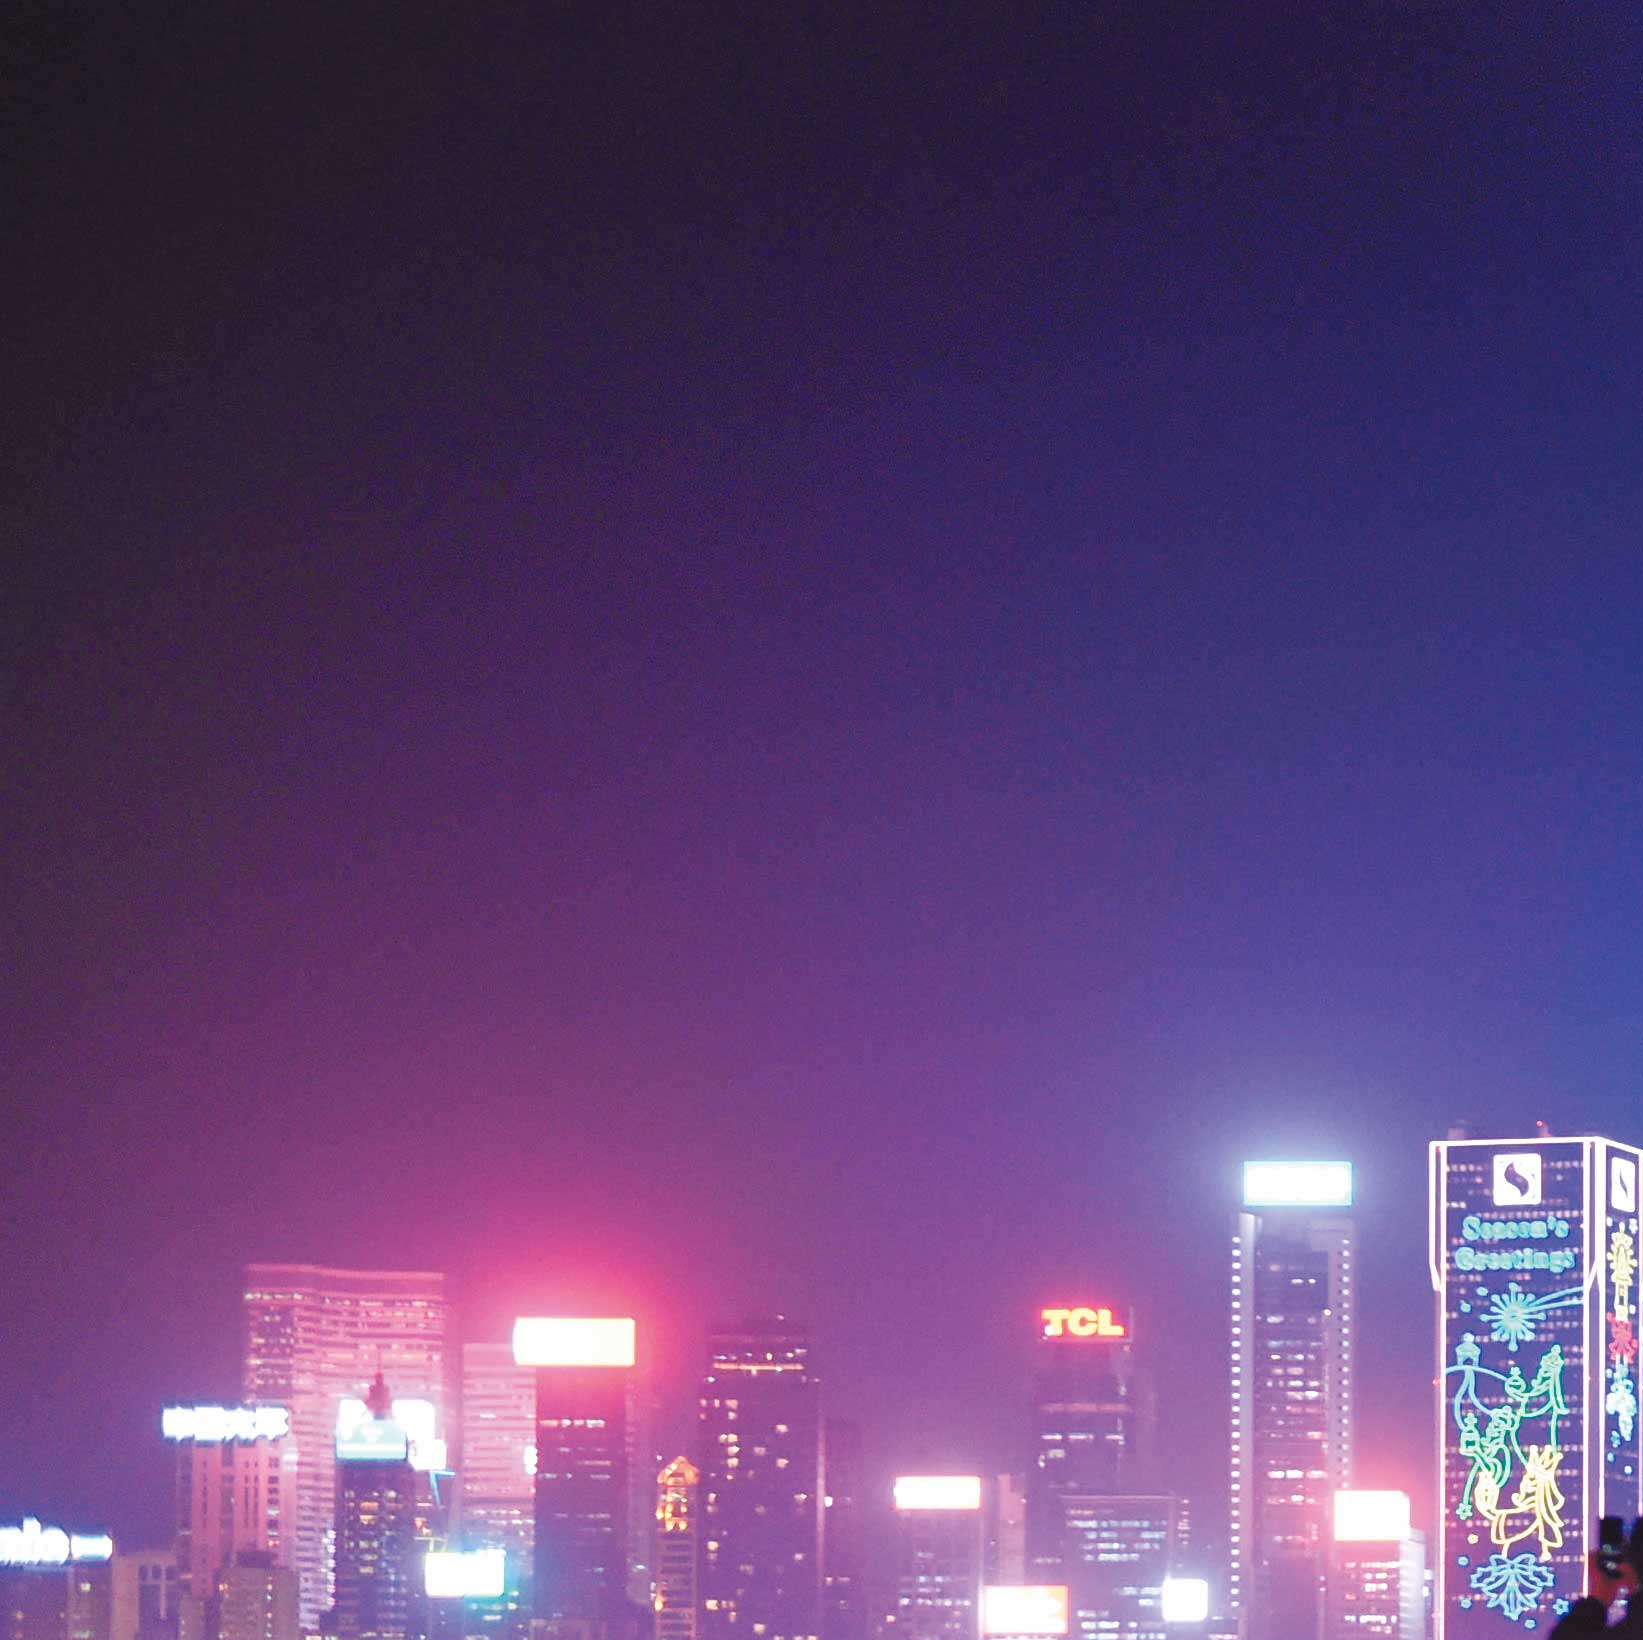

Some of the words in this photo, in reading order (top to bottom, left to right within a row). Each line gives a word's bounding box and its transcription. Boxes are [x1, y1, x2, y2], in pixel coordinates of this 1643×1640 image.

[1462, 1215, 1569, 1240] Season's
[1455, 1246, 1576, 1274] Greetings
[1041, 1307, 1125, 1337] TCL
